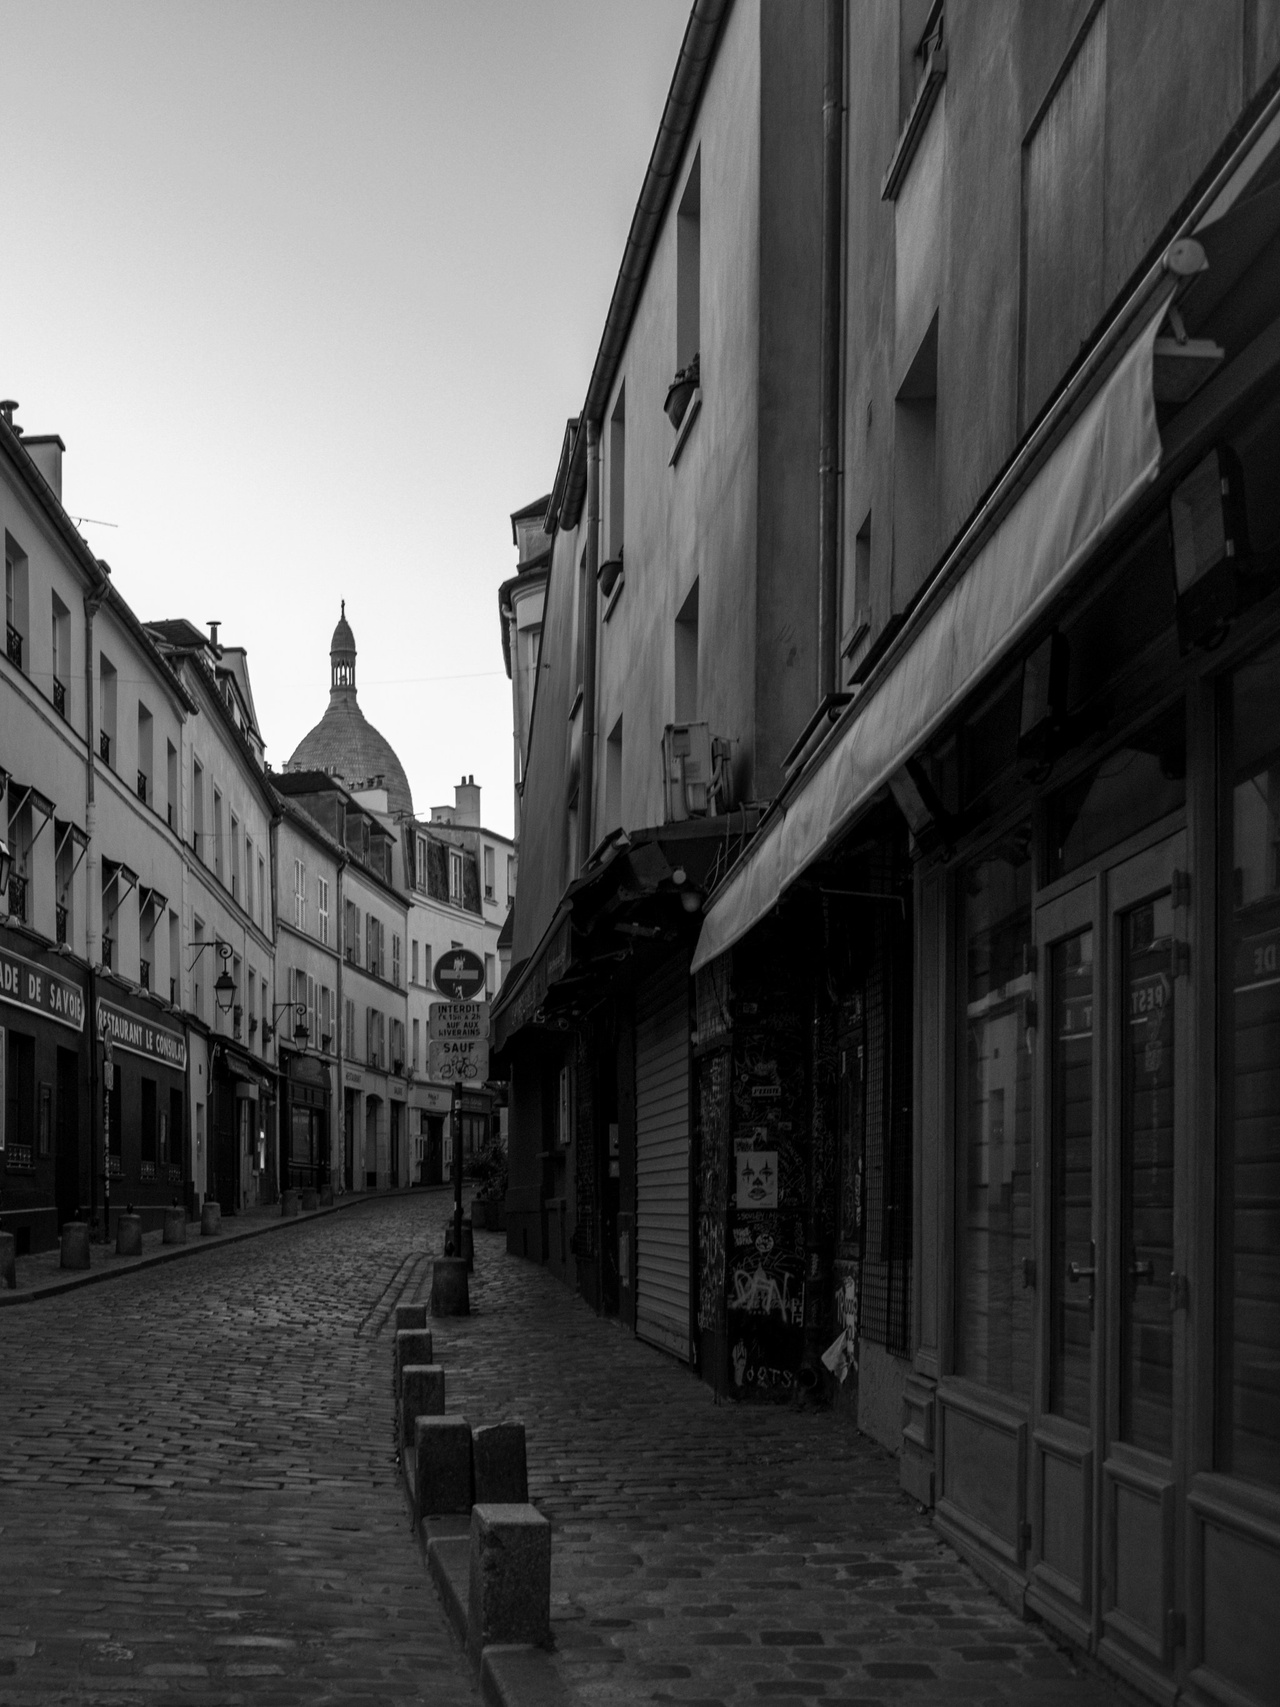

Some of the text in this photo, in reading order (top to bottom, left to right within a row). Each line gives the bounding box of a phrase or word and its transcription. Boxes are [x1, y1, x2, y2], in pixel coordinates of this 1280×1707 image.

[28, 973, 42, 1003] DE
[49, 983, 82, 1022] SAVOIE
[438, 1004, 481, 1014] INTERDIT
[97, 1008, 185, 1062] RESTAURANT LE CONSULAT
[443, 1042, 475, 1053] SAUF
